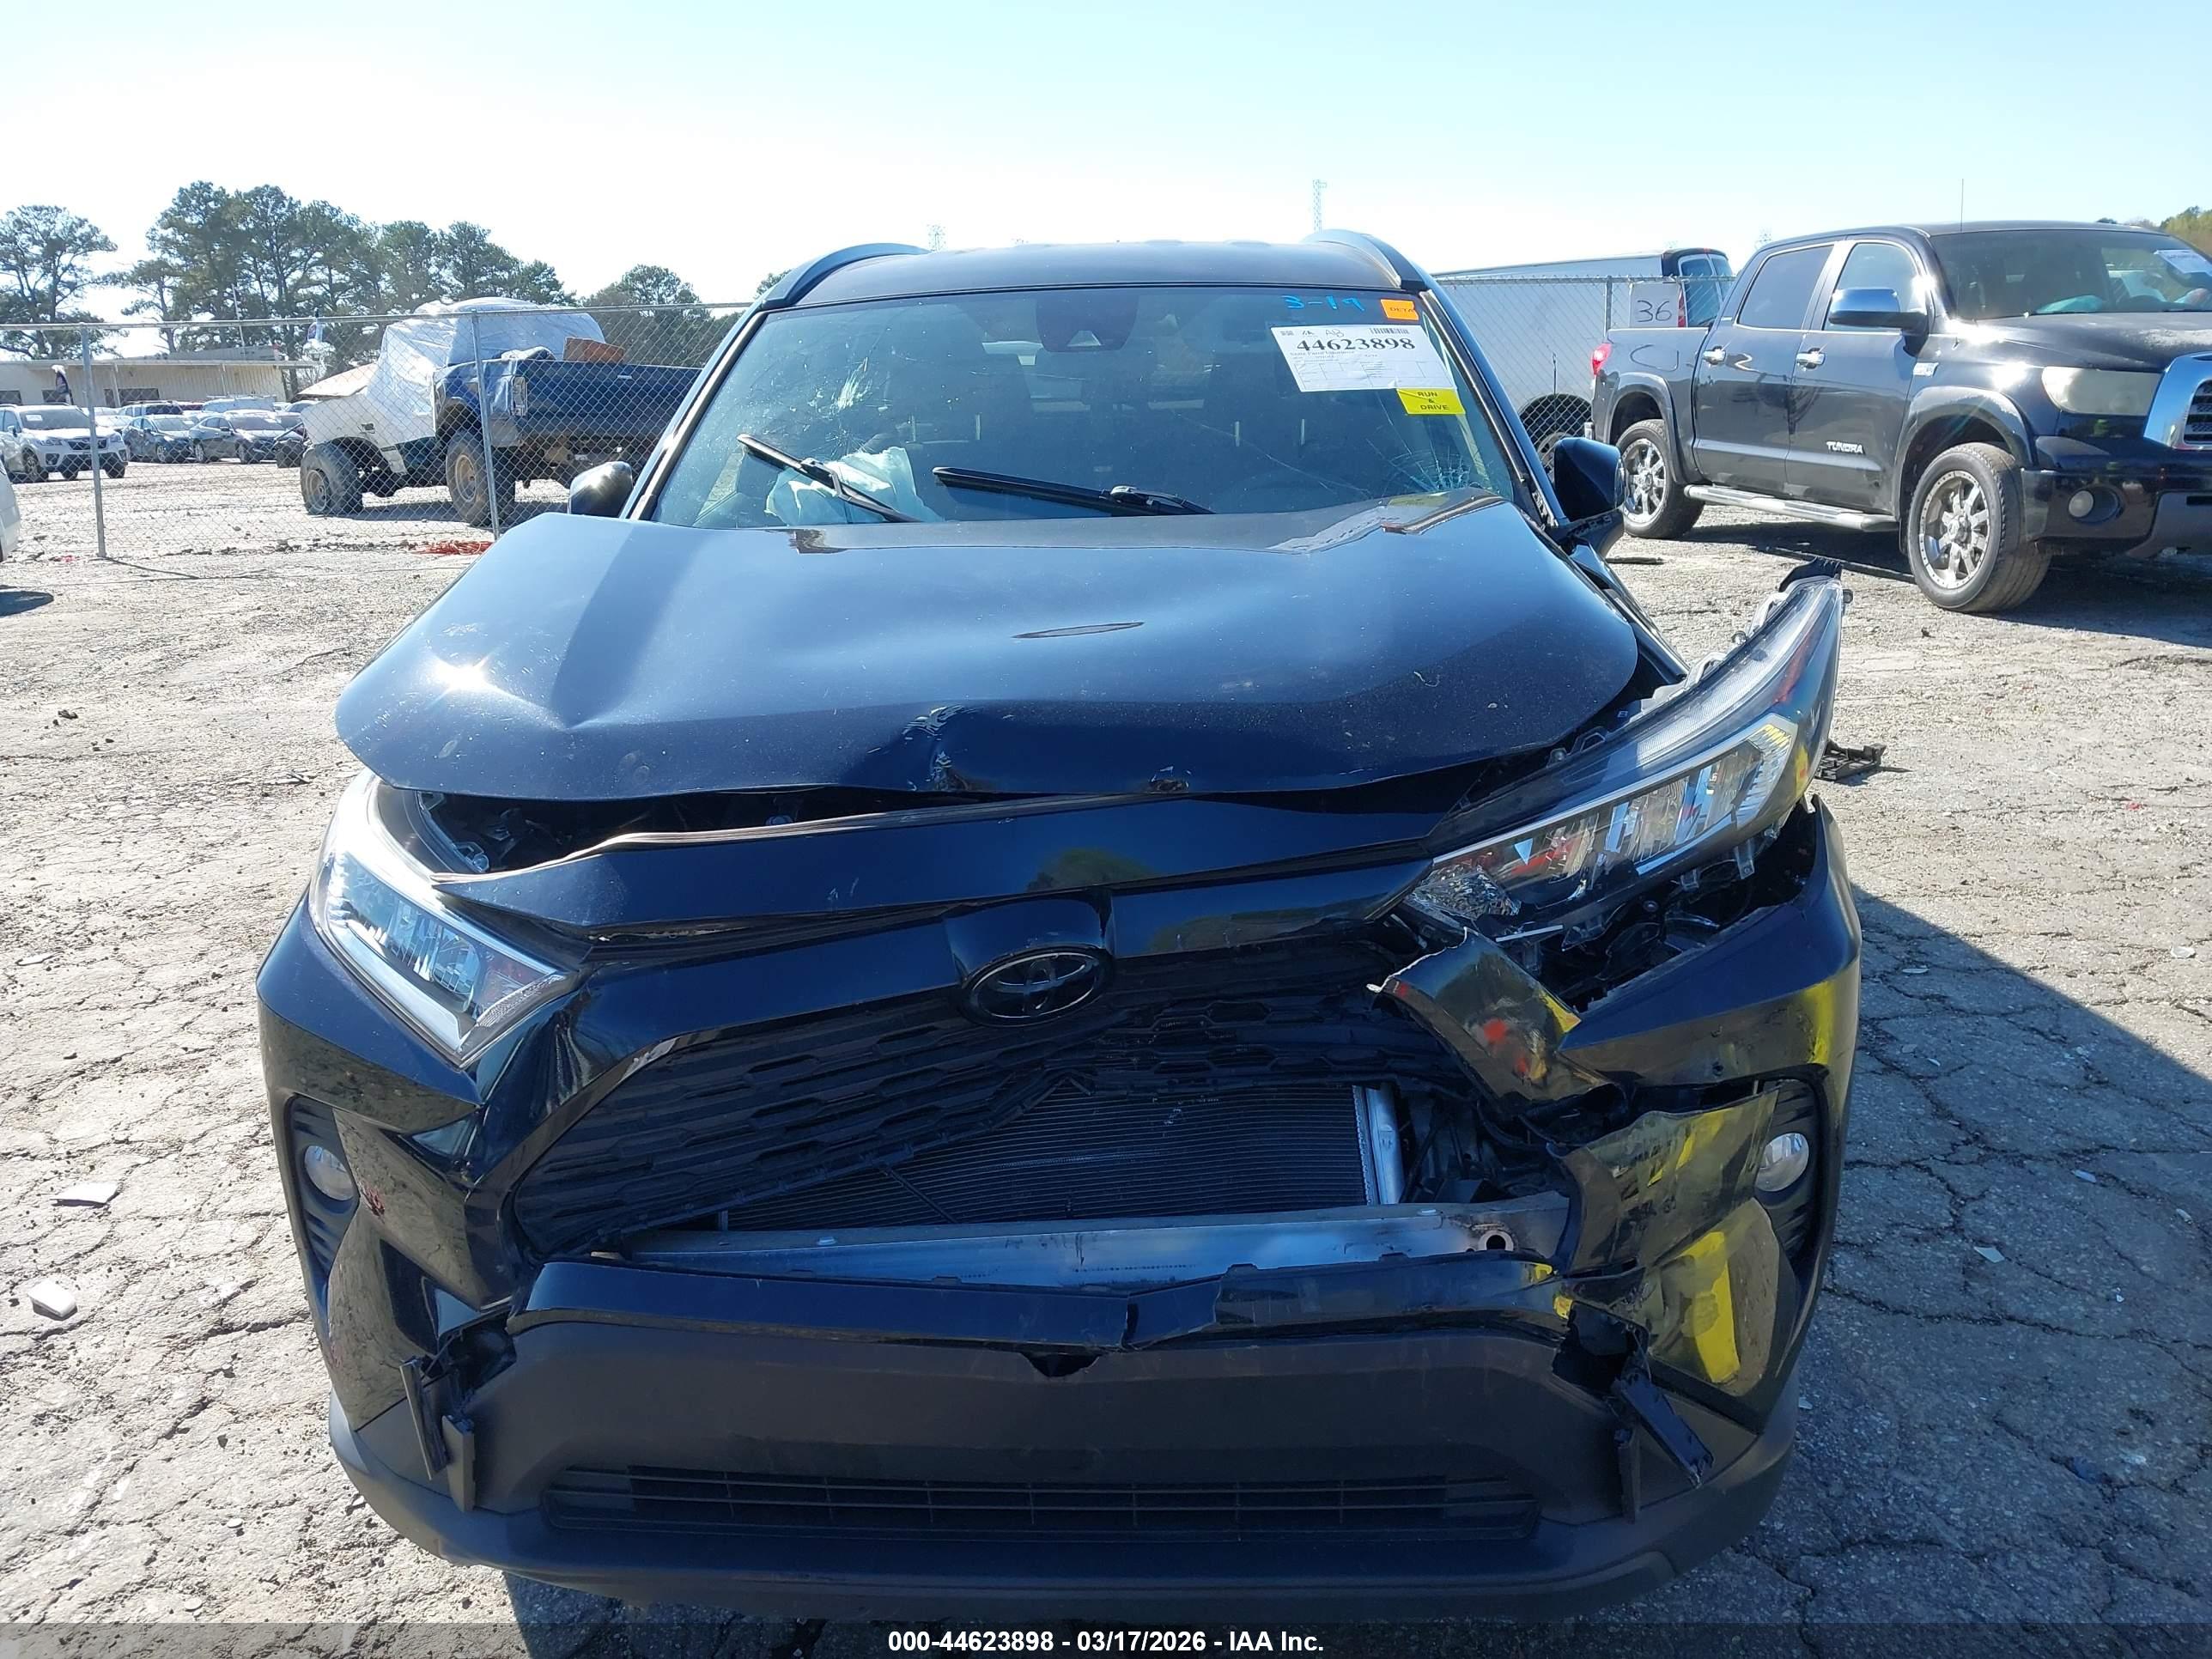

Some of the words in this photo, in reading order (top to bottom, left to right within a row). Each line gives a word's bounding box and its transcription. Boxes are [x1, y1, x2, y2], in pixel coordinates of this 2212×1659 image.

[1281, 295, 1365, 312] 3-19
[1637, 299, 1673, 323] 36
[1297, 337, 1416, 351] 44623898
[1826, 441, 1863, 454] TUNDRA
